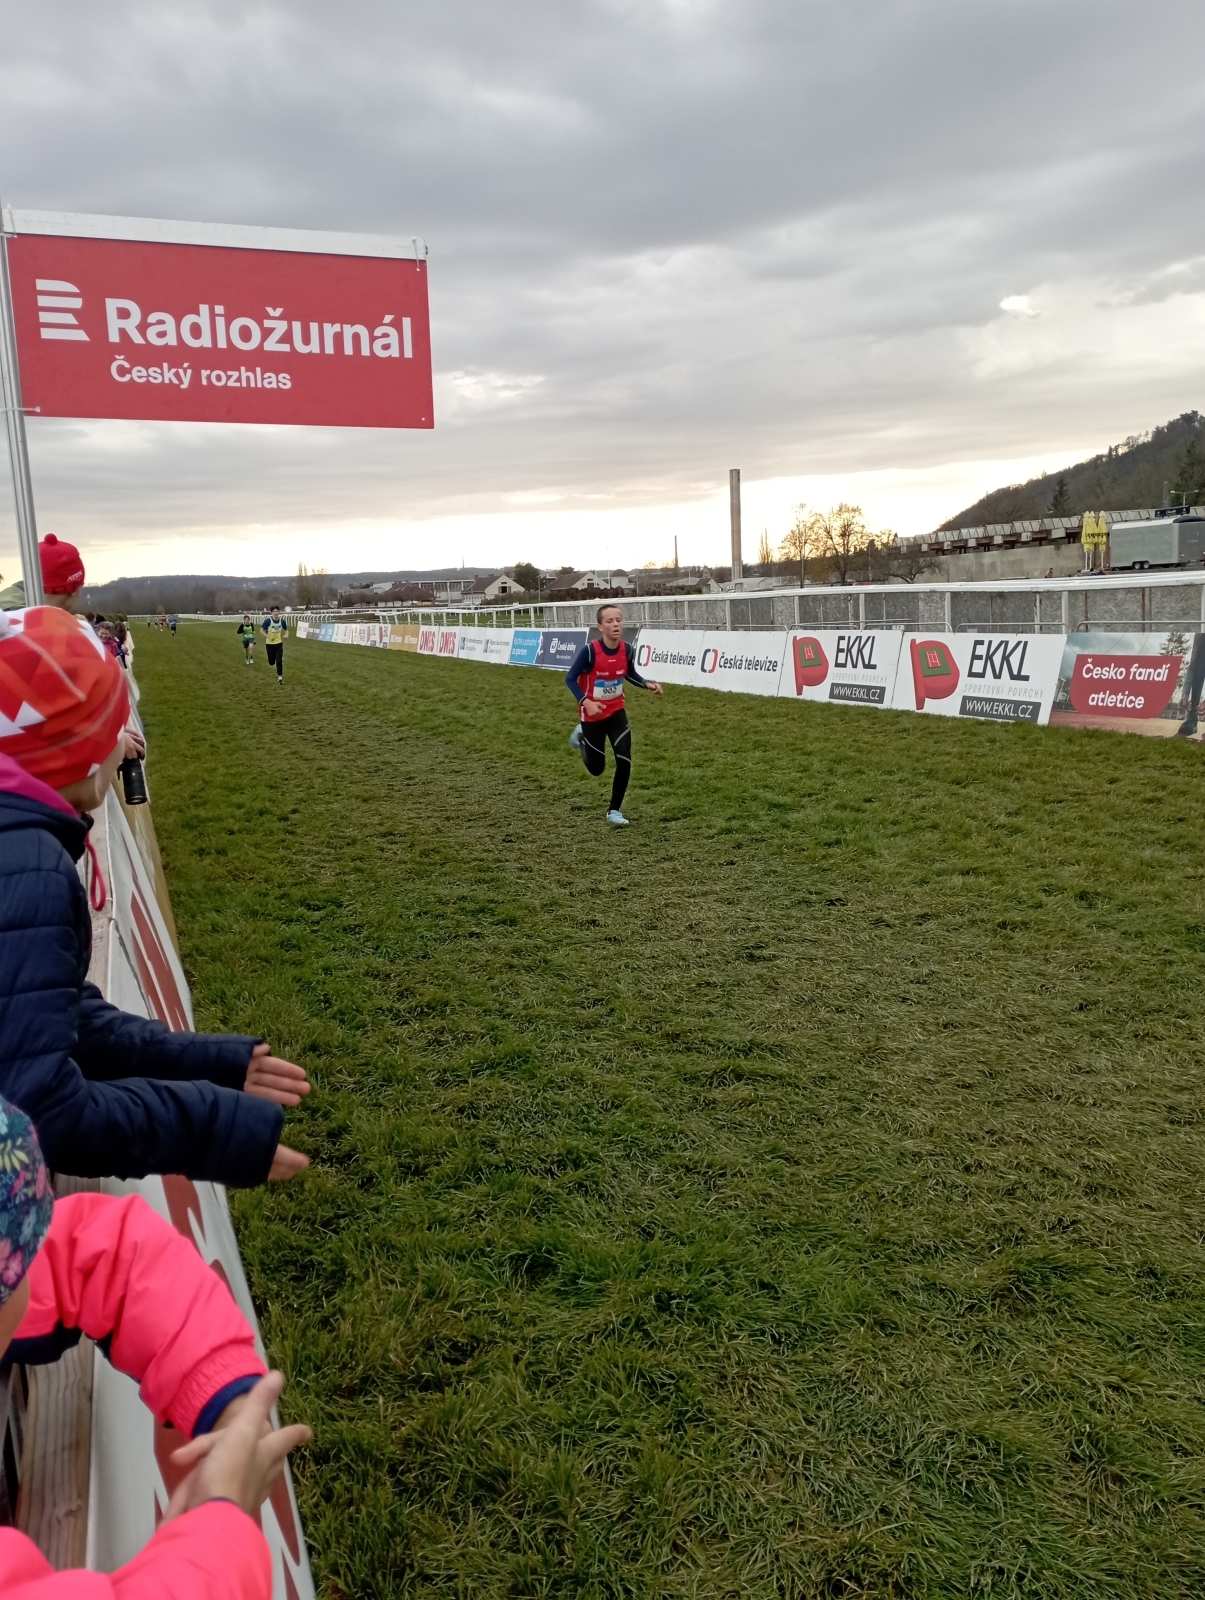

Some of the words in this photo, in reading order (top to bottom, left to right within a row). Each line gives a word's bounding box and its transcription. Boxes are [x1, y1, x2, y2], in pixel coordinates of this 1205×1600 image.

[105, 297, 413, 359] Radiožurnál
[110, 355, 192, 389] Český
[200, 366, 292, 389] rozhlas
[651, 648, 668, 663] Česká
[669, 652, 696, 666] televize
[719, 652, 743, 670] Česká
[745, 655, 778, 672] televize
[834, 635, 877, 670] EKKL
[967, 640, 1030, 681] EKKL
[832, 672, 860, 682] SPORTOVNÍ
[861, 674, 888, 684] POVRCHY
[1082, 658, 1126, 679] Česko
[1129, 662, 1170, 682] fandí
[833, 685, 880, 700] WWW.EKKL.CZ
[964, 684, 1005, 697] SPORTOVNÍ
[1008, 686, 1044, 699] POVRCHY
[1088, 690, 1145, 709] atletice
[966, 699, 1034, 719] WWW.EKKL.CZ
